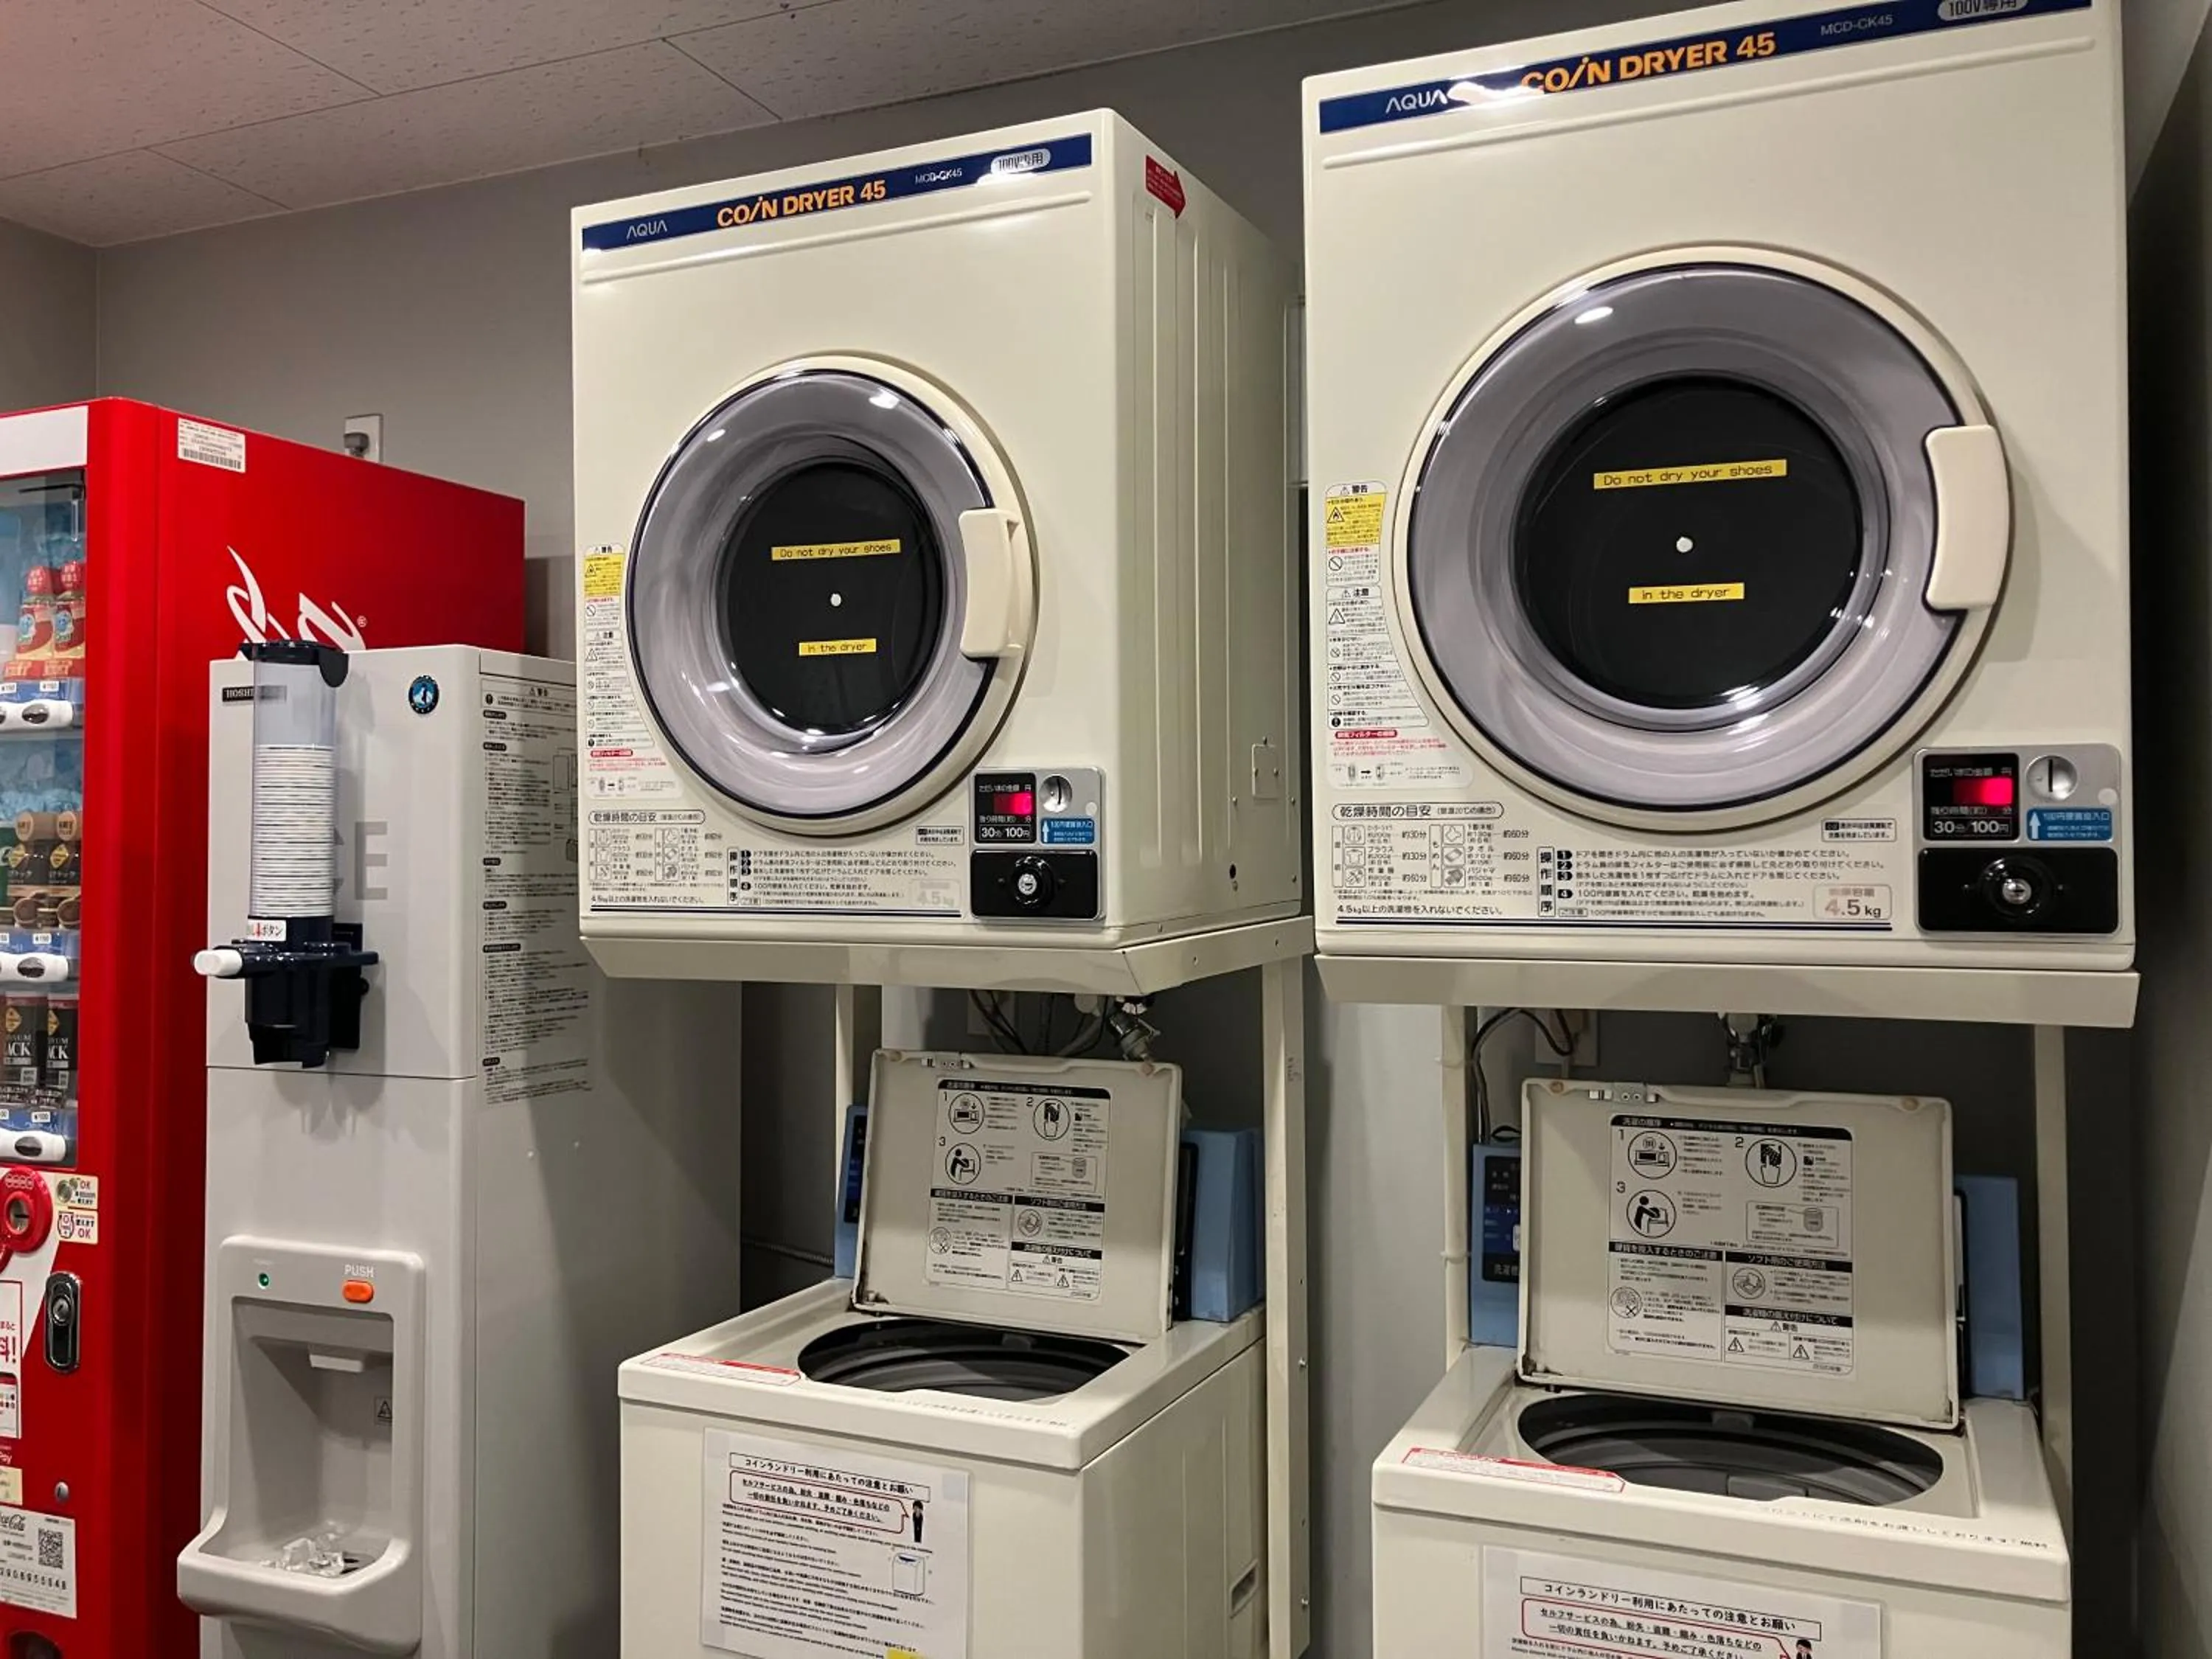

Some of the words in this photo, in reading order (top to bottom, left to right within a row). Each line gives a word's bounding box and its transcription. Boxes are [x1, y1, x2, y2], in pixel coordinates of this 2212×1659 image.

[1820, 14, 1893, 37] MCD-CK45
[1620, 41, 1727, 81] DRYER
[1736, 32, 1776, 58] 45
[783, 185, 855, 214] DRYER
[860, 180, 886, 200] 45
[626, 220, 667, 240] AQUA
[1604, 475, 1621, 486] Do
[1627, 473, 1652, 484] not
[1660, 471, 1683, 481] dry
[1690, 469, 1722, 481] your
[1729, 465, 1773, 476] shoes
[780, 549, 793, 558] Do
[797, 547, 813, 557] not
[818, 546, 833, 557] dry
[838, 546, 859, 554] your
[863, 543, 891, 552] shoes
[1659, 588, 1683, 599] the
[1691, 587, 1731, 599] dryer
[820, 644, 836, 653] the
[840, 643, 866, 653] dryer
[1340, 805, 1431, 817] 乾燥時間の目安
[355, 821, 387, 900] E
[944, 1091, 948, 1101] 1
[1026, 1097, 1034, 1106] 2
[939, 1137, 946, 1146] 3
[1618, 1130, 1624, 1140] 1
[1735, 1137, 1744, 1148] 2
[1616, 1181, 1626, 1194] 3
[344, 1265, 374, 1277] PUSH
[745, 1458, 914, 1495] コインランドリー利用にあたっての注意とお願い
[1545, 1584, 1796, 1630] コインランドリー利用にあたっての注意とお願い
